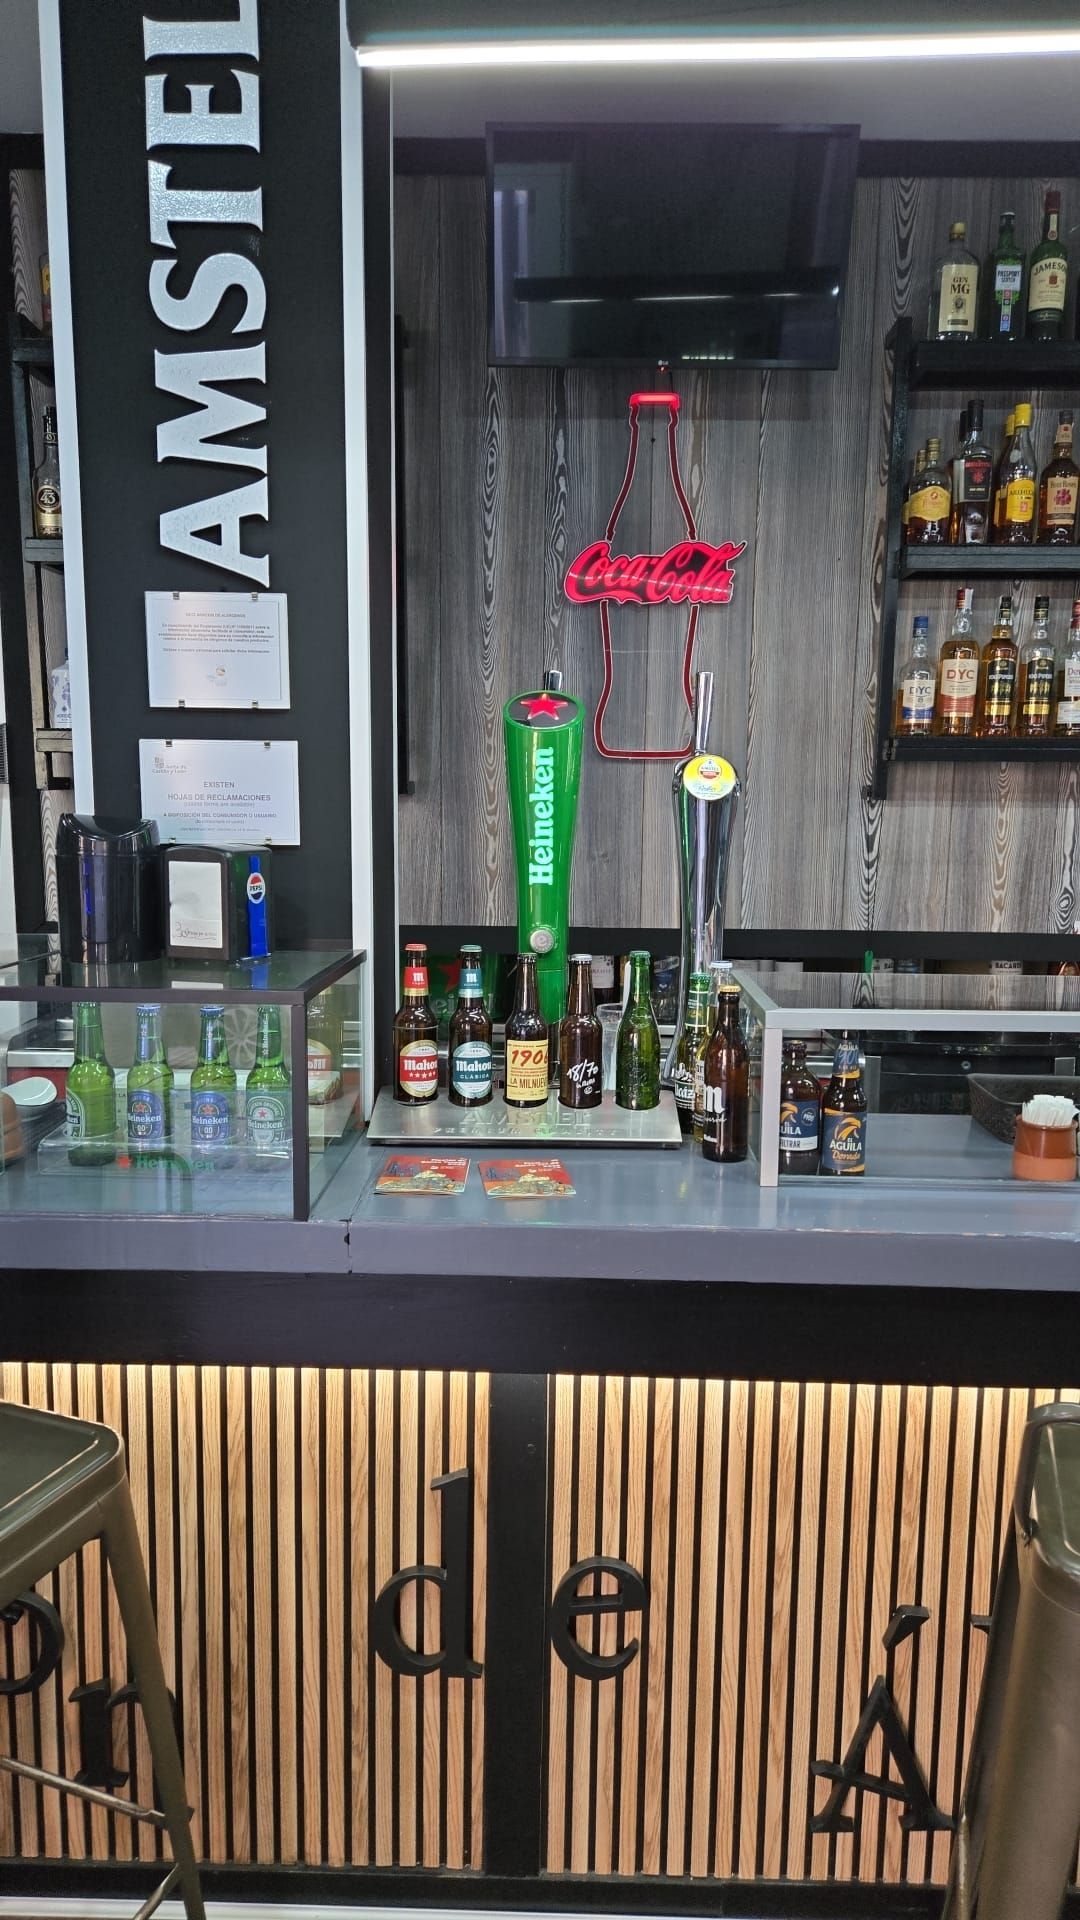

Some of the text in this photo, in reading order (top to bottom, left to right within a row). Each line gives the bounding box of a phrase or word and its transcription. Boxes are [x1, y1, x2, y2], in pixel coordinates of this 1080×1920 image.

[1034, 261, 1067, 276] JAMESO
[143, 0, 270, 588] AMSTEL
[950, 283, 970, 295] MG
[40, 490, 56, 505] 43
[946, 668, 975, 680] DYC
[909, 686, 932, 695] DYC
[168, 793, 193, 801] HOJAS
[206, 794, 271, 802] RECLAMACIONES
[528, 746, 555, 886] Heineken
[192, 1114, 229, 1126] Heineken
[247, 1118, 284, 1129] Heineken
